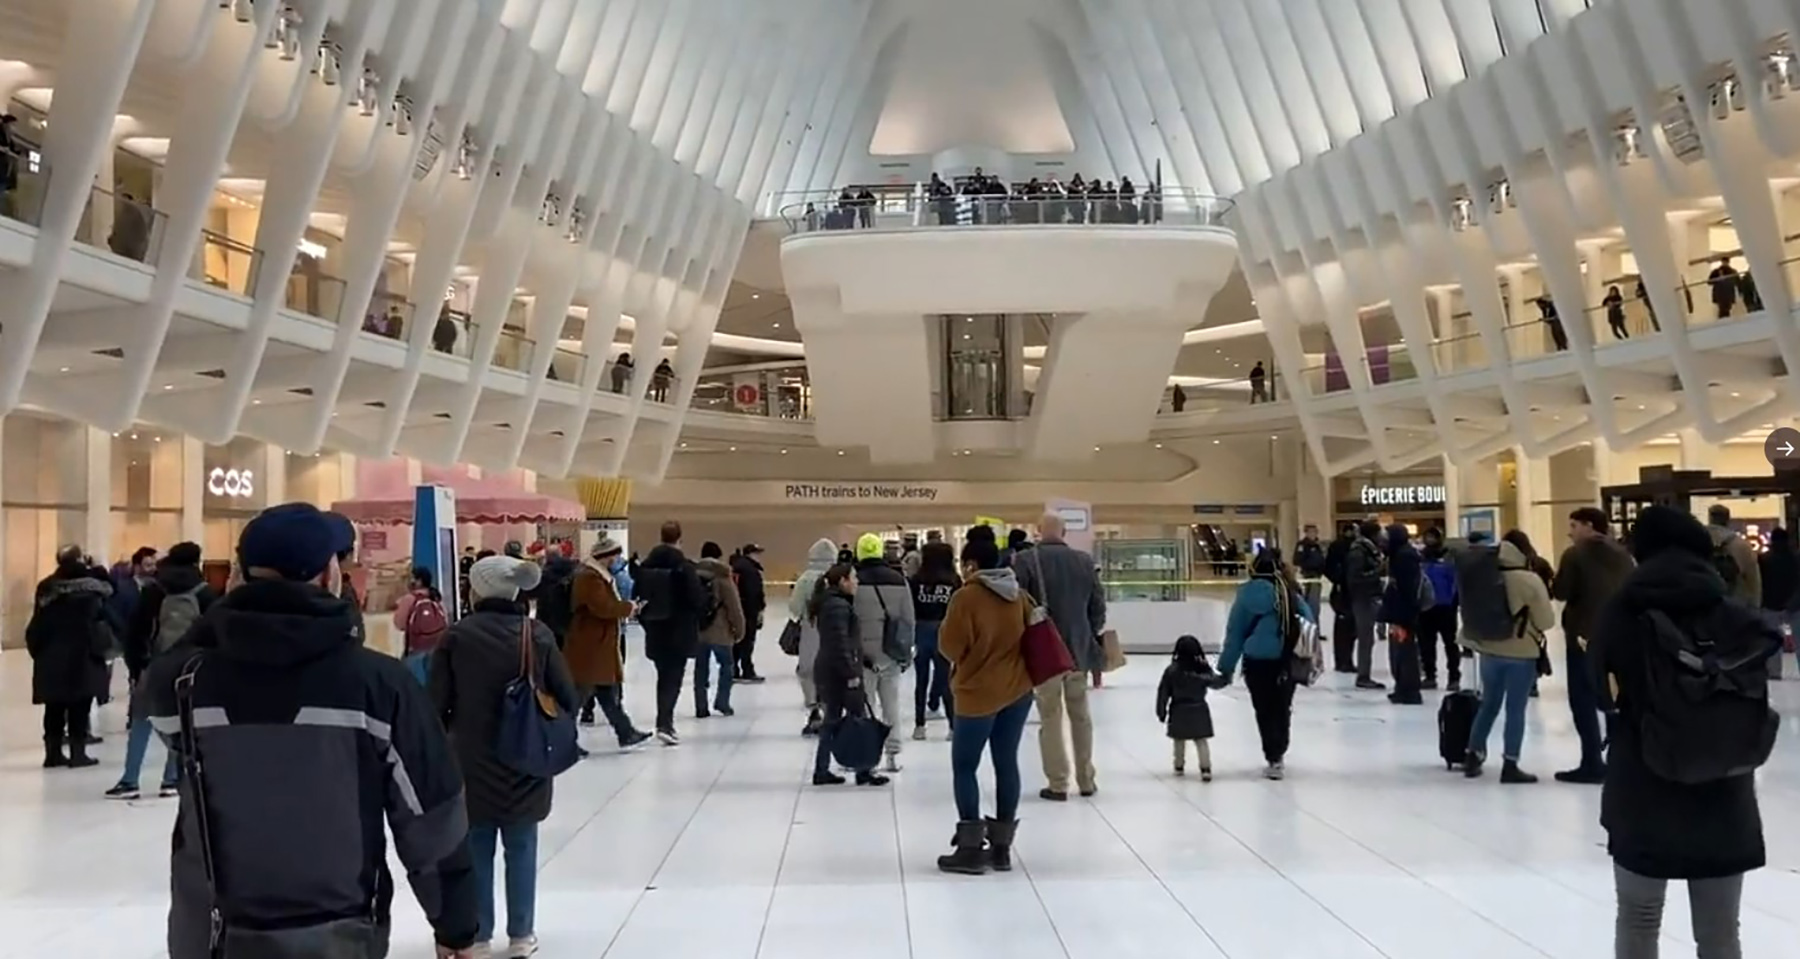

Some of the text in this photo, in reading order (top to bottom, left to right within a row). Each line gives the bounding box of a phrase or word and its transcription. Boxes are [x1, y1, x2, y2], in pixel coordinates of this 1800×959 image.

[209, 467, 253, 497] COS
[786, 485, 937, 500] PATH trains to New Jersey
[1361, 485, 1415, 504] ÉPICERIE
